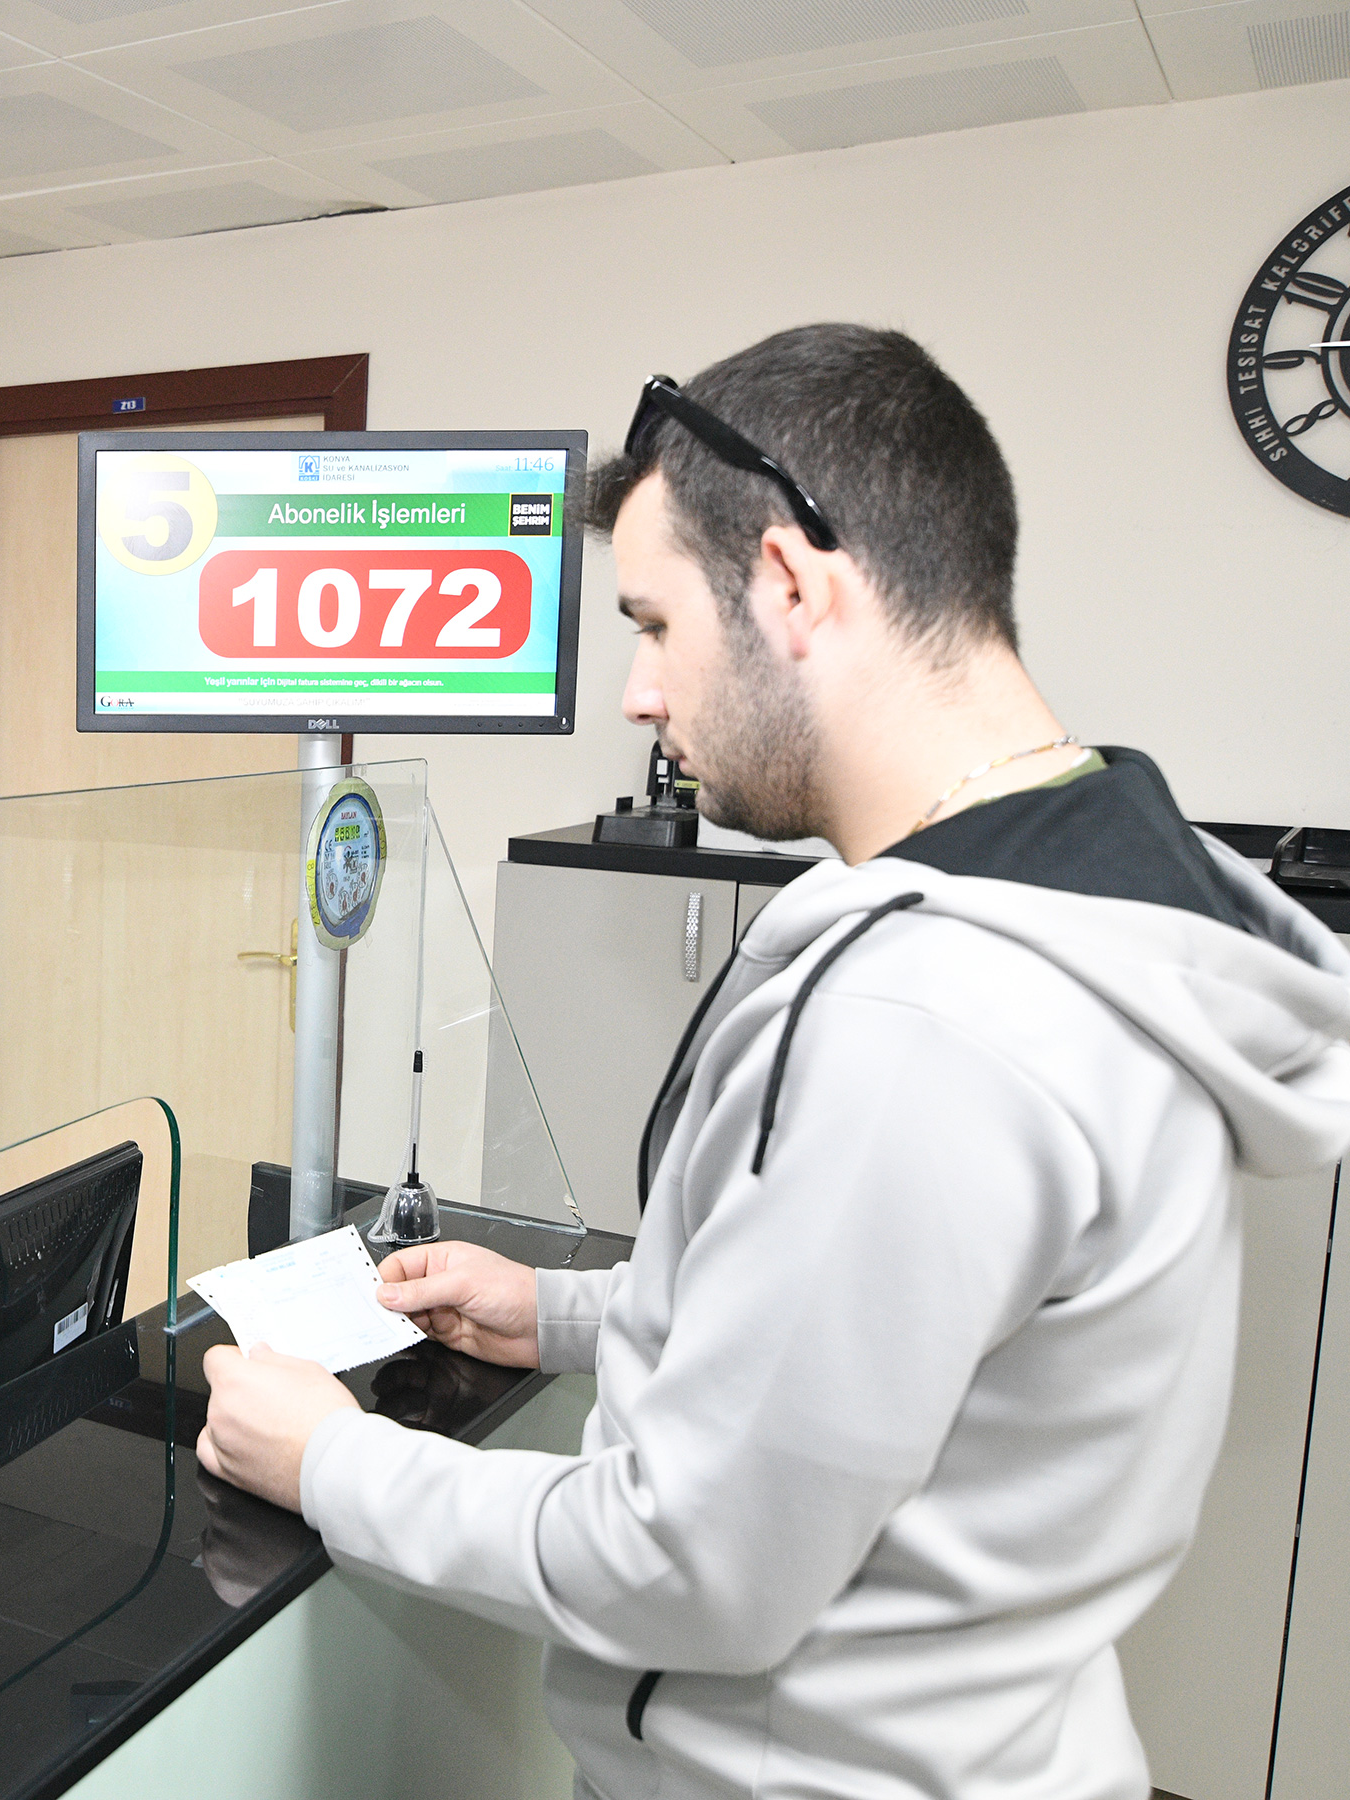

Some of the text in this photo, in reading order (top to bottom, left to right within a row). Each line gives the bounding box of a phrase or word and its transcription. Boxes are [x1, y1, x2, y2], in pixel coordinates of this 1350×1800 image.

[1283, 271, 1348, 315] 10
[514, 457, 555, 472] 11:46
[120, 471, 194, 563] 5
[267, 499, 466, 530] Abonelik İşlemleri
[512, 503, 550, 515] BENİM
[232, 567, 502, 648] 1072
[260, 677, 275, 688] için
[307, 718, 340, 730] DELL
